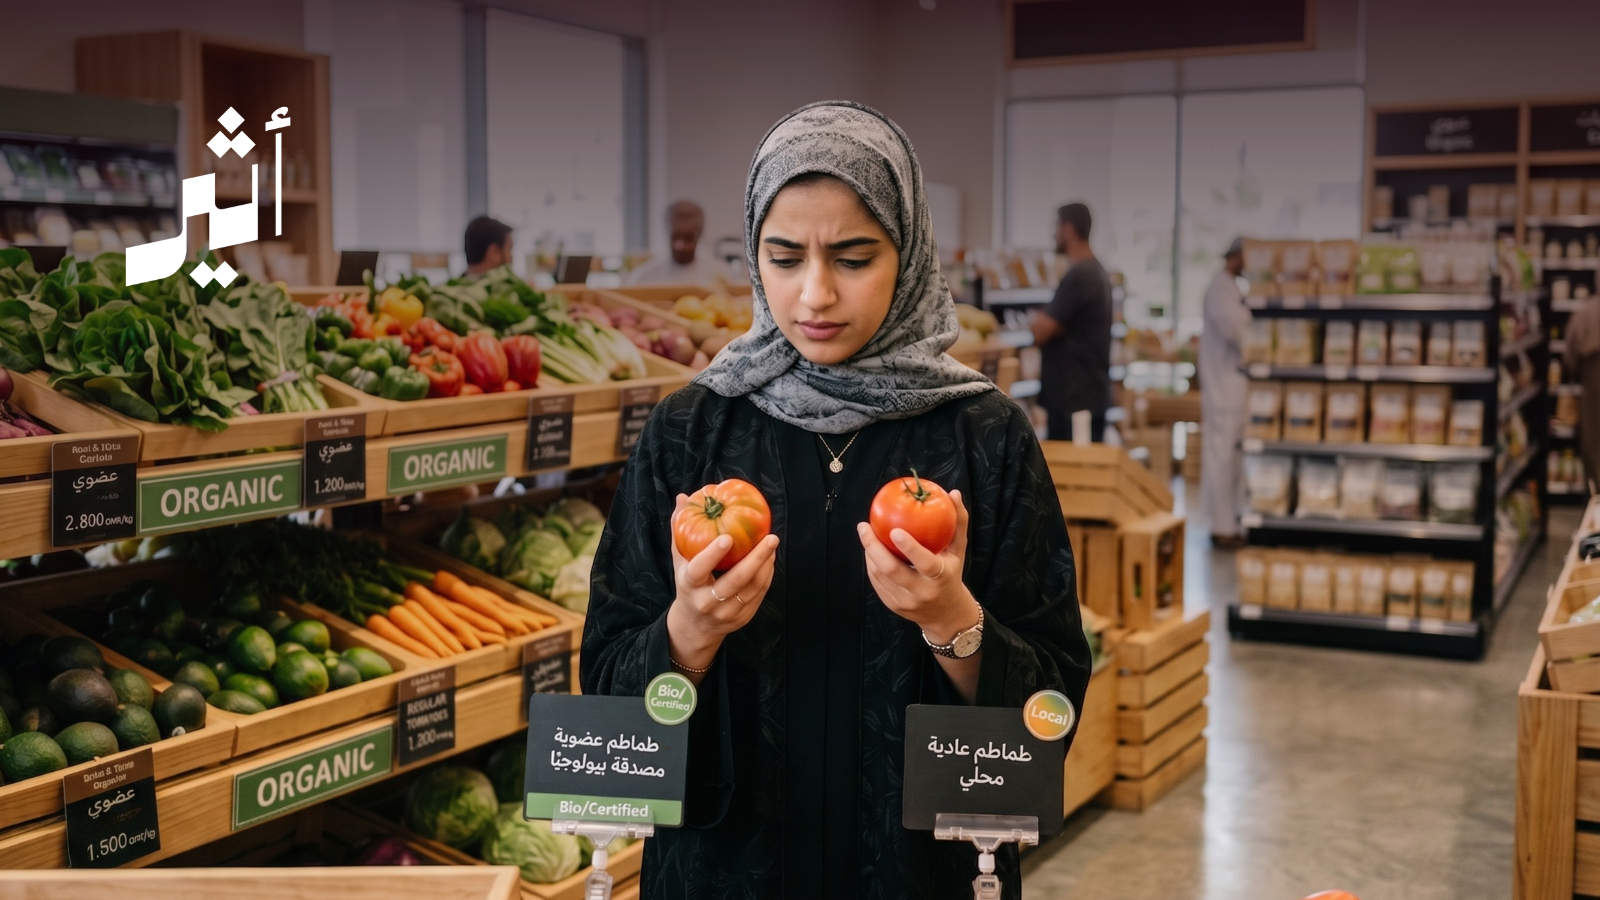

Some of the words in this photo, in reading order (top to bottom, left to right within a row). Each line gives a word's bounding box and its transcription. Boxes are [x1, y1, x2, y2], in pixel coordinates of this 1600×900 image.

[92, 443, 100, 452] &
[403, 444, 496, 482] ORGANIC
[72, 471, 119, 493] عضوي
[314, 476, 345, 495] 1.200
[160, 474, 284, 518] ORGANIC
[65, 512, 105, 531] 2.800
[657, 684, 687, 700] Bio/
[407, 693, 448, 716] REGULAR
[650, 697, 690, 712] Certified
[1031, 706, 1069, 726] Local
[554, 727, 603, 748] عضوية
[606, 734, 659, 755] طماطم
[927, 735, 970, 758] عادية
[973, 742, 1033, 764] طماطم
[106, 766, 113, 776] &
[256, 742, 376, 808] ORGANIC
[611, 757, 665, 778] مصدقة
[959, 765, 1005, 792] محلي
[88, 789, 136, 819] عضوي
[559, 800, 649, 818] Bio/Certified
[87, 832, 128, 861] 1.500
